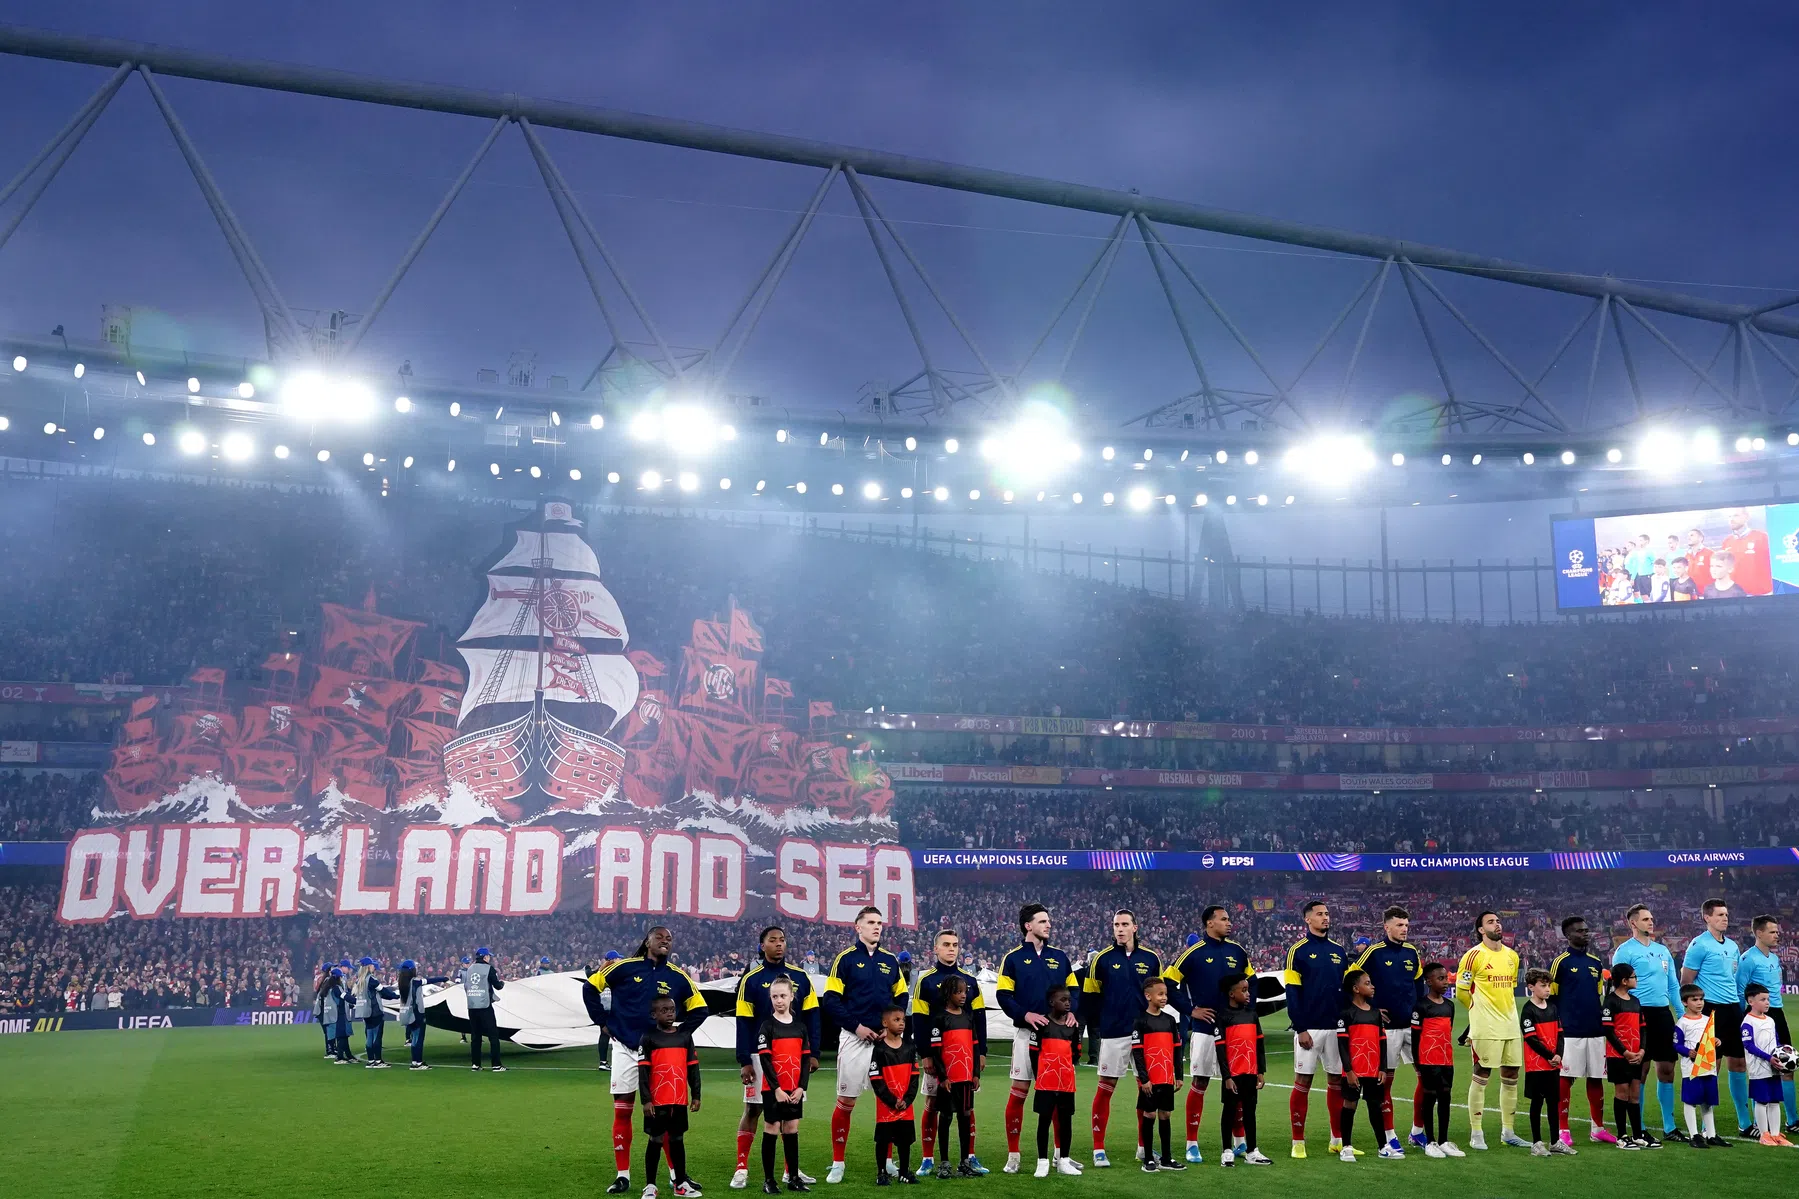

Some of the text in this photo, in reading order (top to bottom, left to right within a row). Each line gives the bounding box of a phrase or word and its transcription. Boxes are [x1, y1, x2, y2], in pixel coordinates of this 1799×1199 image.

[1231, 728, 1256, 739] 2010
[1358, 731, 1380, 741] 2011
[901, 766, 943, 779] Liberia
[968, 768, 1012, 781] Arsenal
[1158, 773, 1194, 785] ARSENAL
[1208, 773, 1242, 786] SWEDEN
[923, 854, 1068, 865] UEFA CHAMPIONS LEAGUE
[1222, 856, 1254, 866] PEPSI
[1390, 857, 1530, 867] UEFA CHAMPIONS LEAGUE
[1667, 852, 1745, 863] QATAR AIRWAYS
[57, 823, 918, 929] OVER LAND AND SEA
[118, 1015, 173, 1030] UEFA
